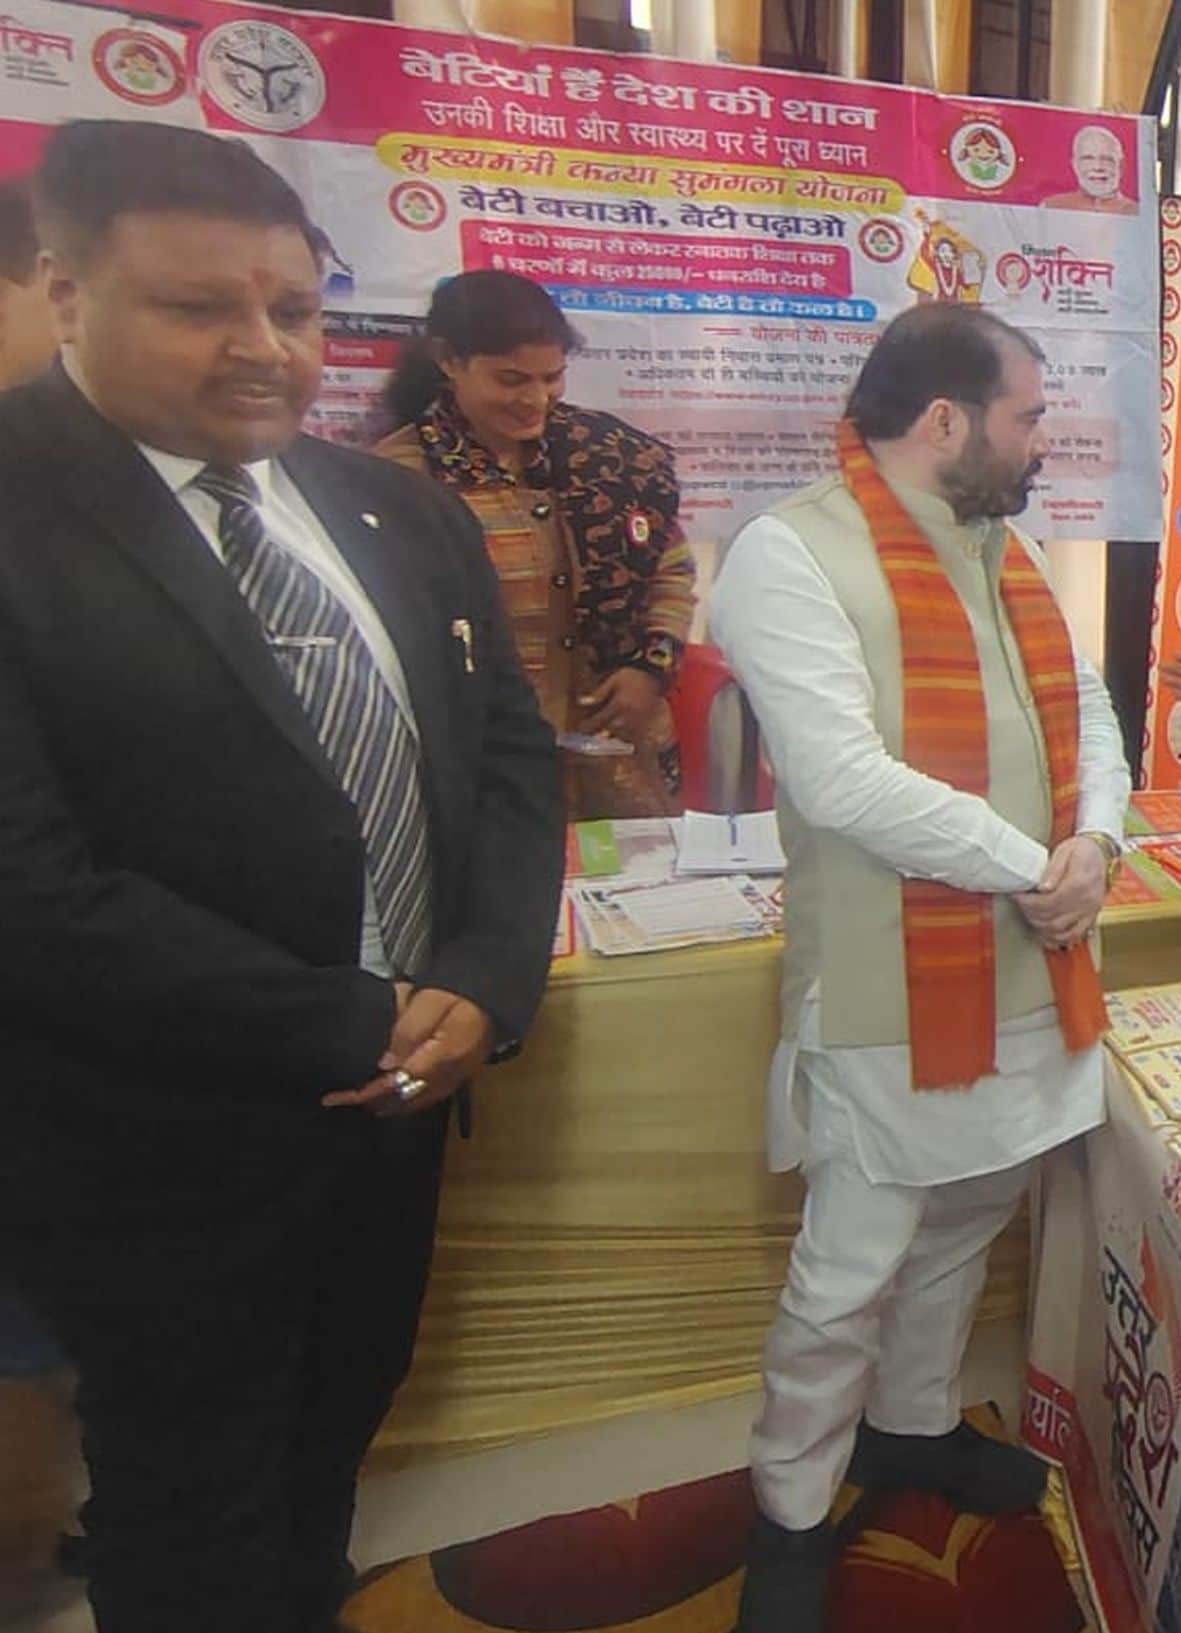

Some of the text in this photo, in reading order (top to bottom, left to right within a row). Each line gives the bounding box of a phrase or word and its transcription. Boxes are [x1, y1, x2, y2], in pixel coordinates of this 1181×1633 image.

[399, 46, 879, 131] बेटियां हैं देश की शान
[421, 96, 868, 168] उनकी शिक्षा और स्वास्थ्य पर दें पूरा ध्यान
[400, 143, 559, 177] मुख्यमंत्री
[566, 159, 659, 187] कन्या
[795, 175, 889, 206] योजना
[458, 185, 531, 215] बेटी
[679, 203, 740, 231] बेटी
[744, 209, 848, 239] पढ़ाओ
[1032, 245, 1115, 303] शक्ति
